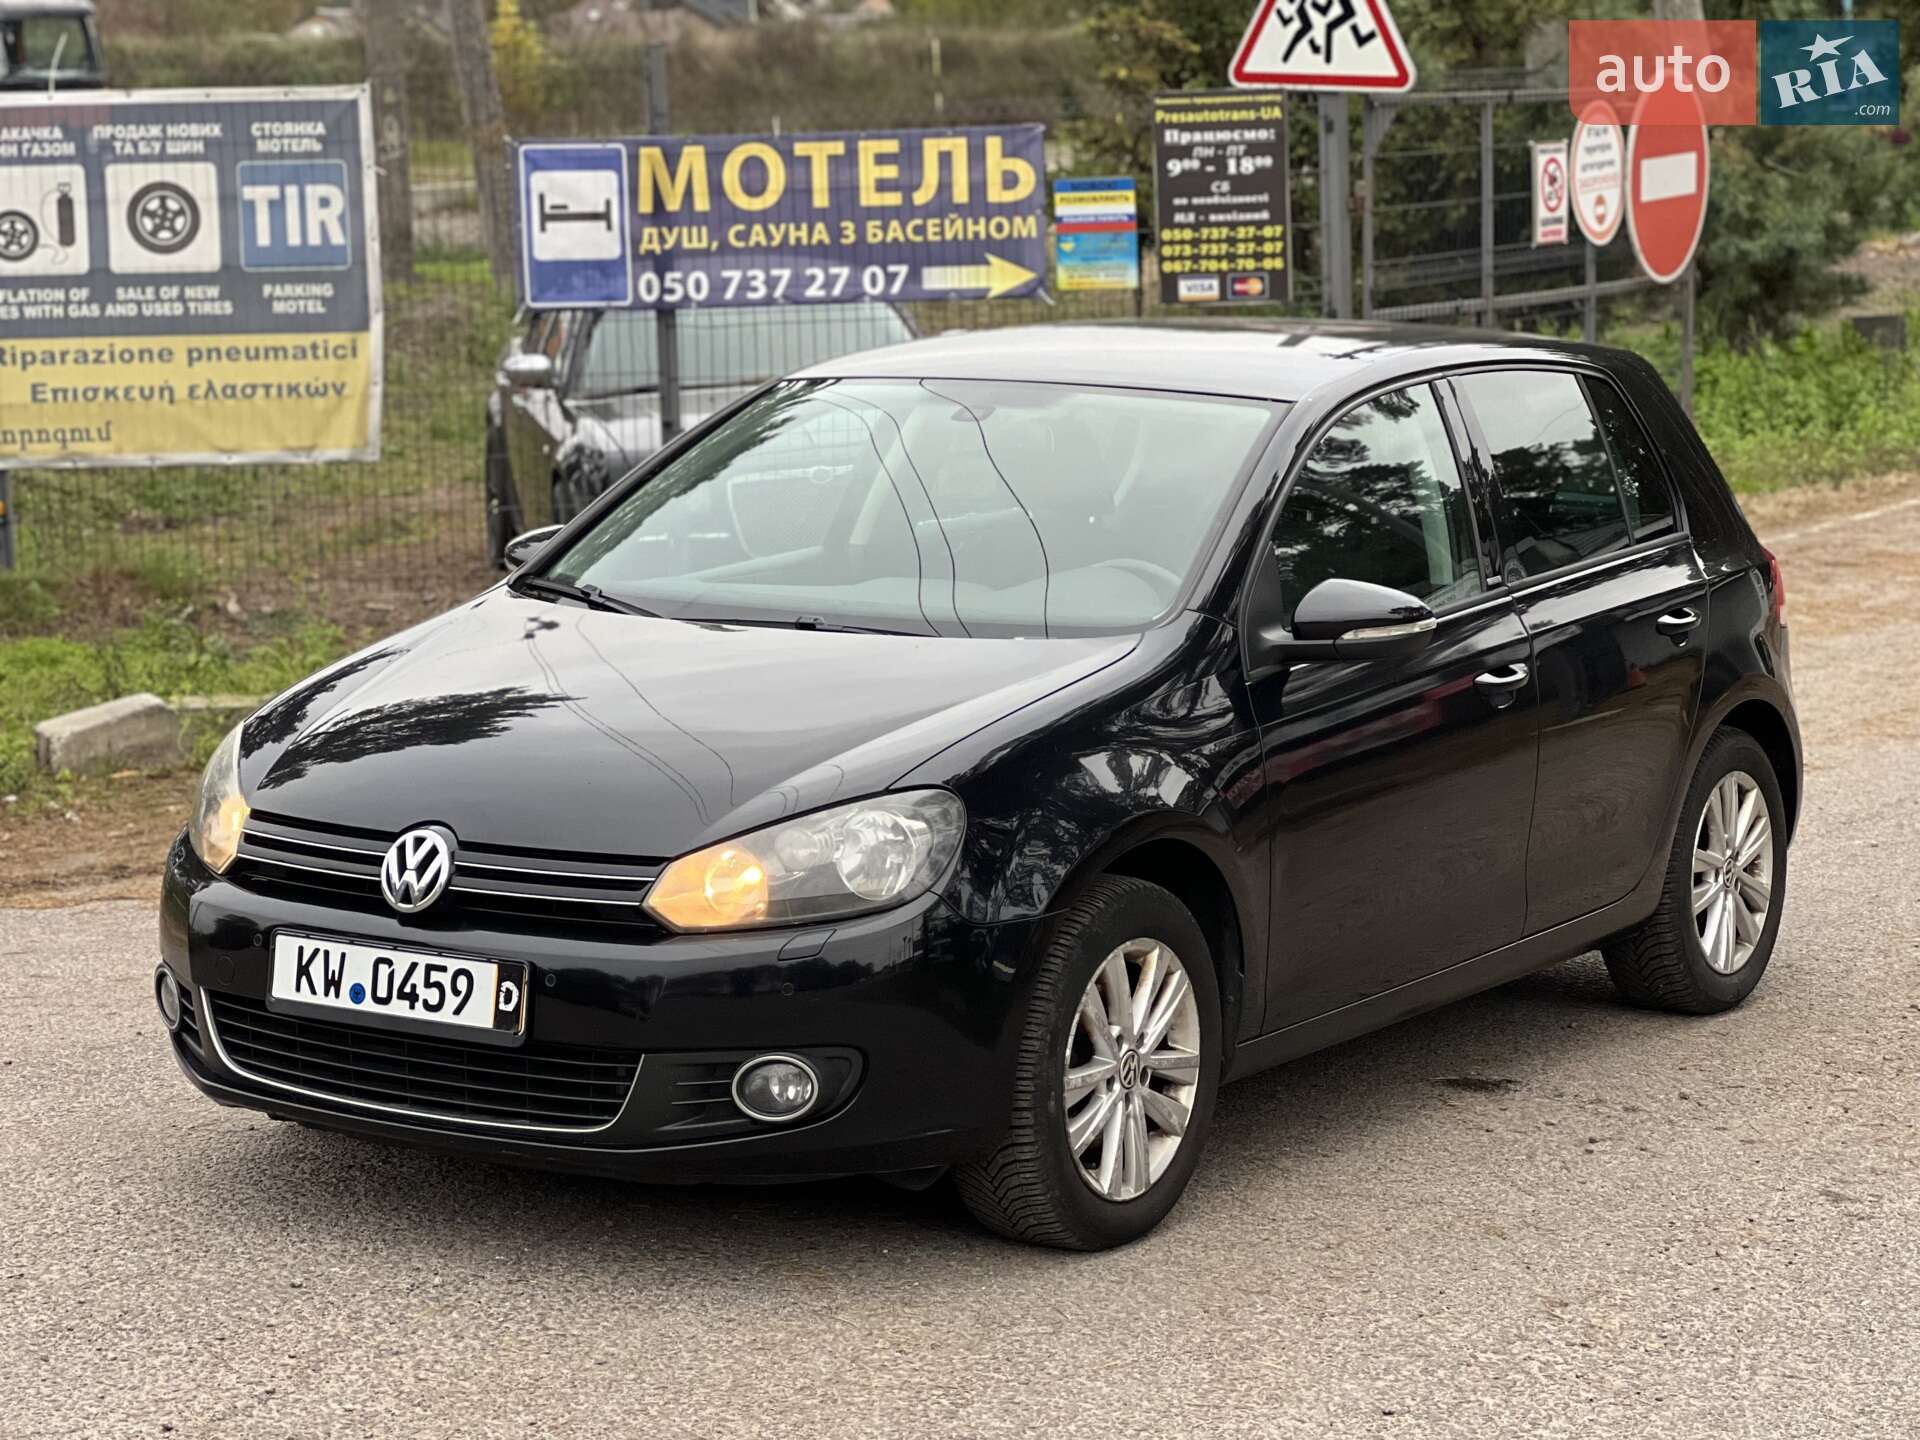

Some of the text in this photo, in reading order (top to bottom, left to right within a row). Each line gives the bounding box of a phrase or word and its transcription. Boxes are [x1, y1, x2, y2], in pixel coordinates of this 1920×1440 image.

[93, 123, 222, 140] ПРОДАЖ НОВИХ
[251, 121, 327, 137] СТОЯНКА
[22, 141, 76, 157] ГАЗОМ
[113, 141, 135, 155] ТА
[166, 139, 204, 155] ШИН
[256, 137, 323, 153] МОТЕЛЬ
[638, 135, 1037, 214] МОТЕЛЬ
[242, 184, 346, 247] TIR
[639, 225, 720, 255] ДУШ,
[728, 220, 830, 248] САУНА
[866, 213, 1038, 244] БАСЕЙНОМ
[262, 282, 335, 298] PARKING
[638, 264, 909, 303] 050 737 27 07
[68, 287, 90, 302] OF
[116, 285, 220, 301] SALE OF NEW
[22, 303, 64, 319] WITH
[67, 302, 101, 318] GAS
[104, 300, 234, 317] AND USED TIRES
[271, 298, 328, 314] MOTEL
[187, 338, 359, 367] pneumatici
[294, 945, 347, 999] KW
[371, 956, 476, 1016] 0459
